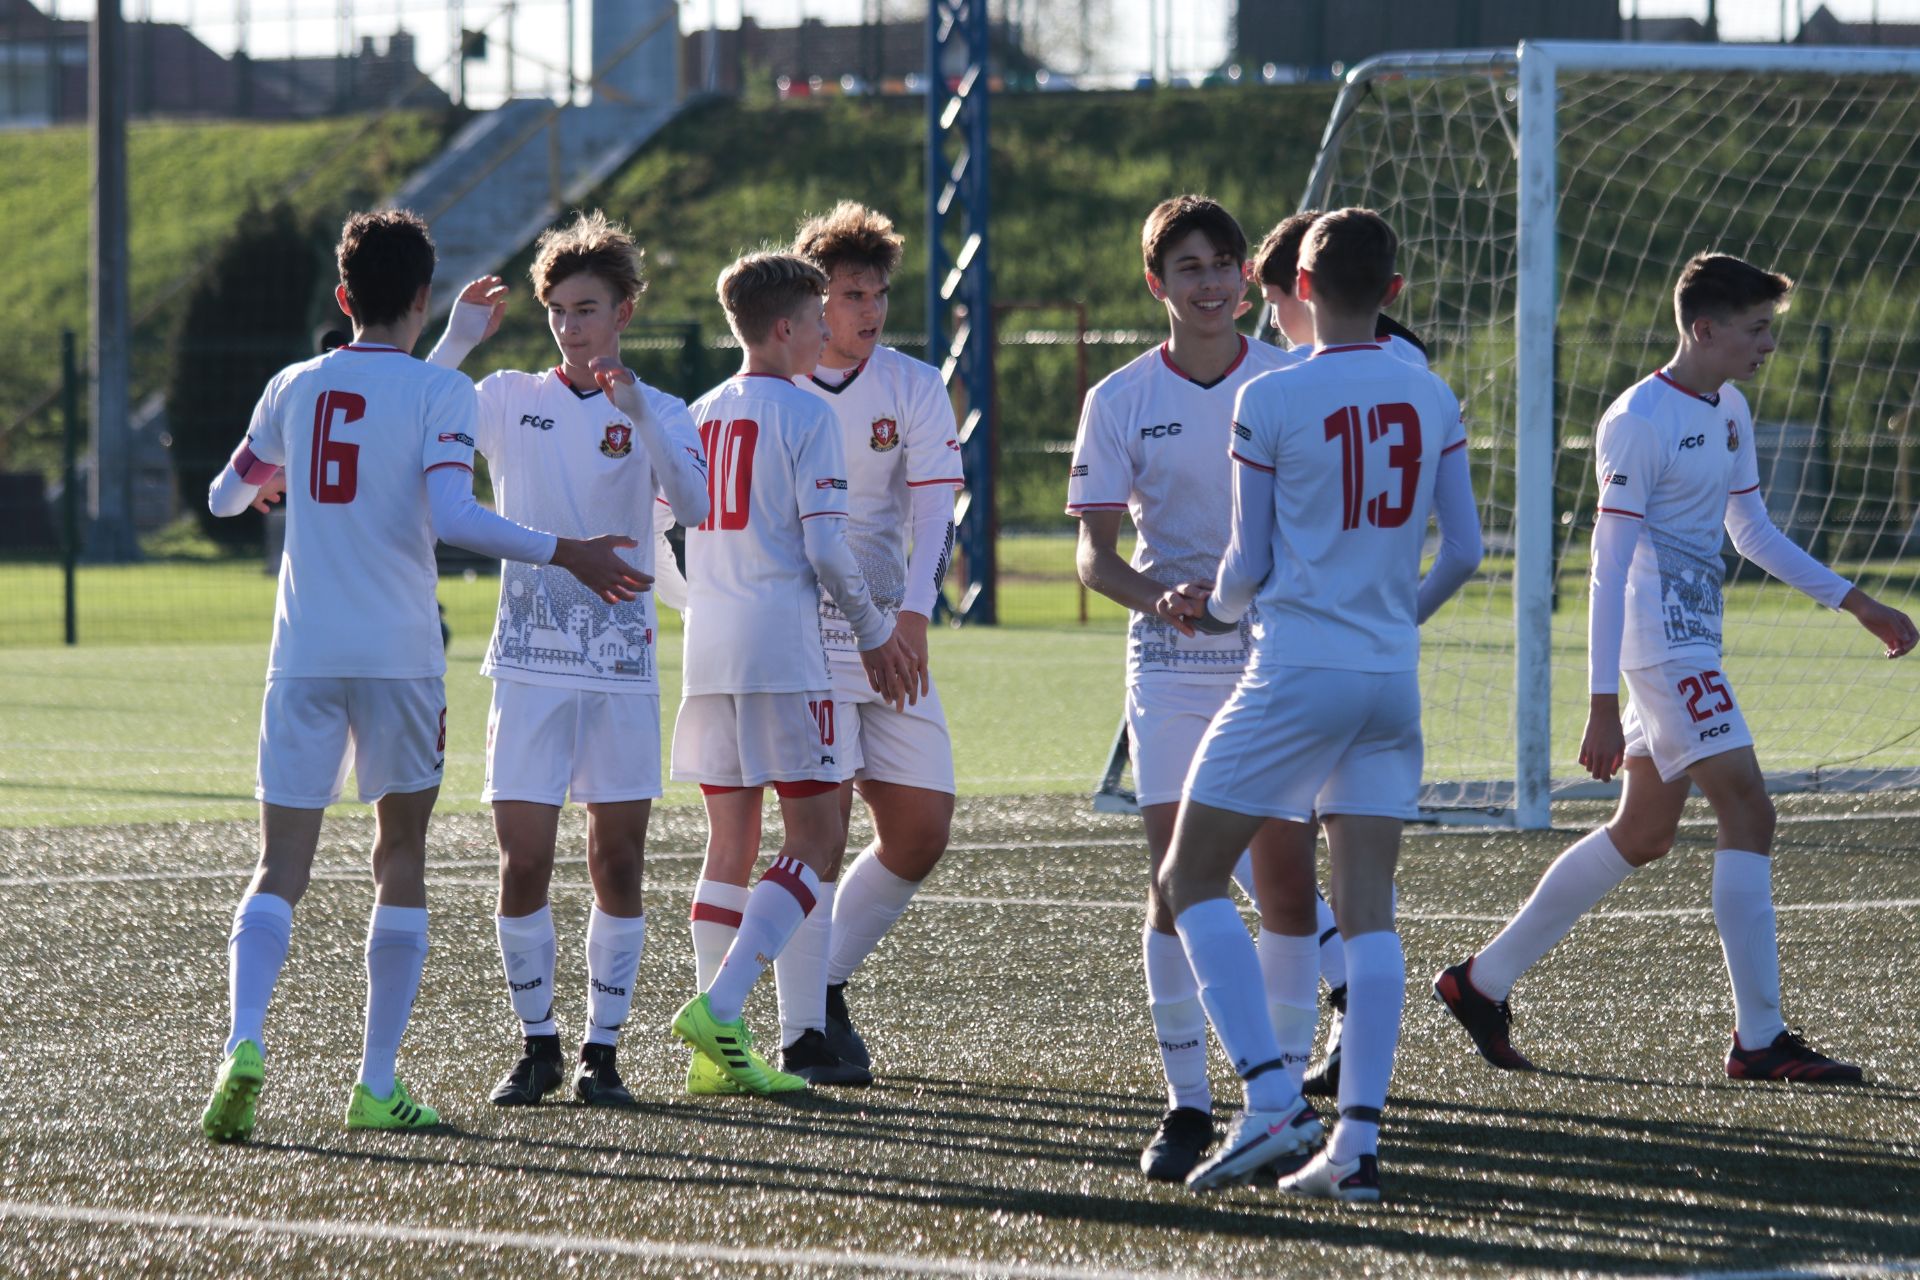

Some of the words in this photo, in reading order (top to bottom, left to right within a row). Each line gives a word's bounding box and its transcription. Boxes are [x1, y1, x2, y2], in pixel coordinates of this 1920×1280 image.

[520, 414, 555, 430] FCG
[1141, 422, 1182, 440] FCG
[310, 390, 366, 504] 6
[1678, 434, 1704, 451] FCG
[698, 419, 759, 531] 10
[1323, 402, 1422, 531] 13
[1678, 670, 1733, 723] 25
[1700, 723, 1730, 741] FCG
